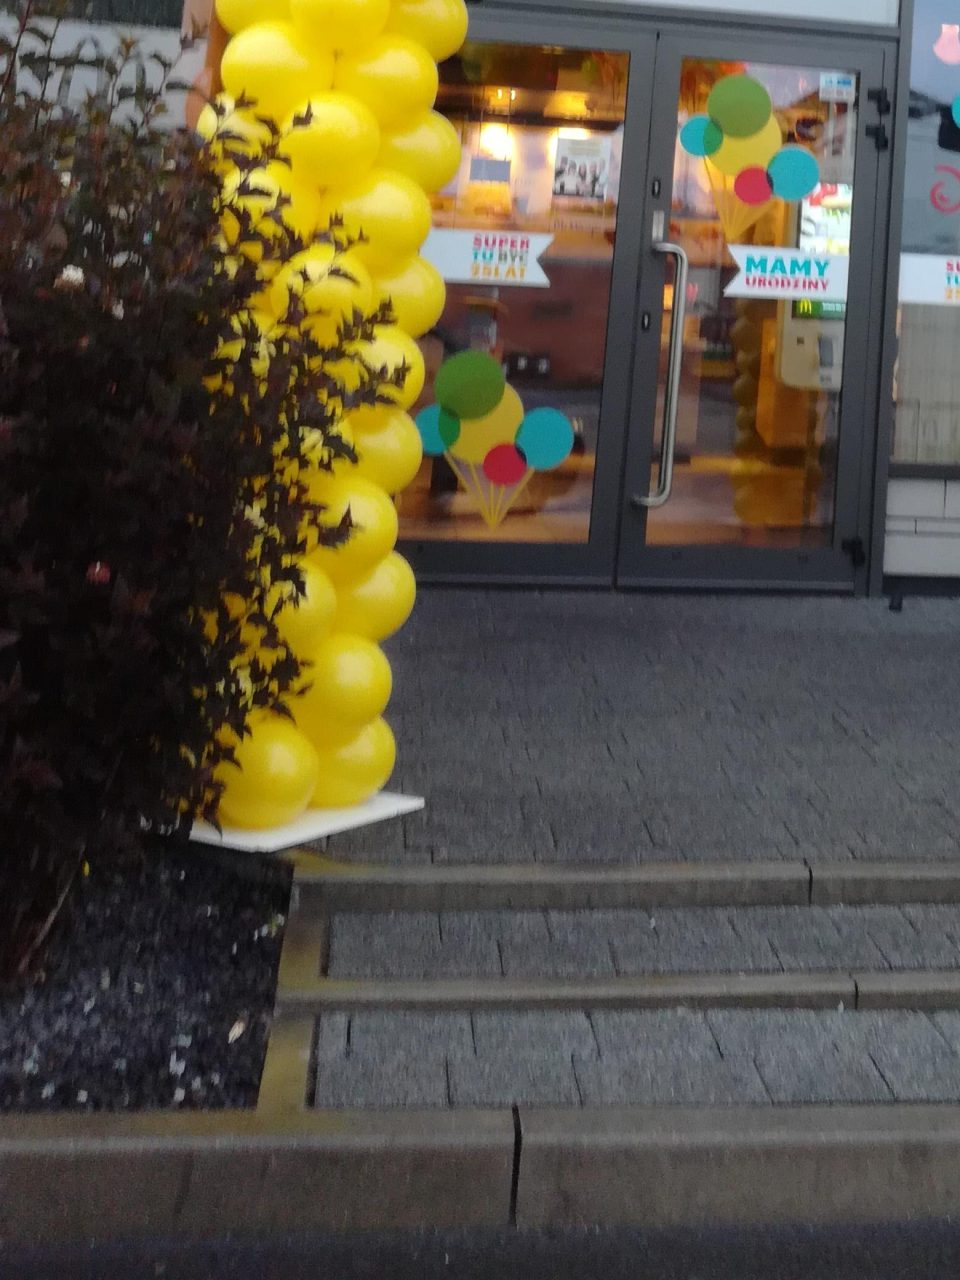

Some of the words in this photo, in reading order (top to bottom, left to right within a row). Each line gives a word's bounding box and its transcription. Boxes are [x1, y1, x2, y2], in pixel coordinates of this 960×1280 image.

[473, 233, 530, 249] SUPER
[745, 255, 829, 277] MAMY
[745, 275, 829, 291] URODZINY
